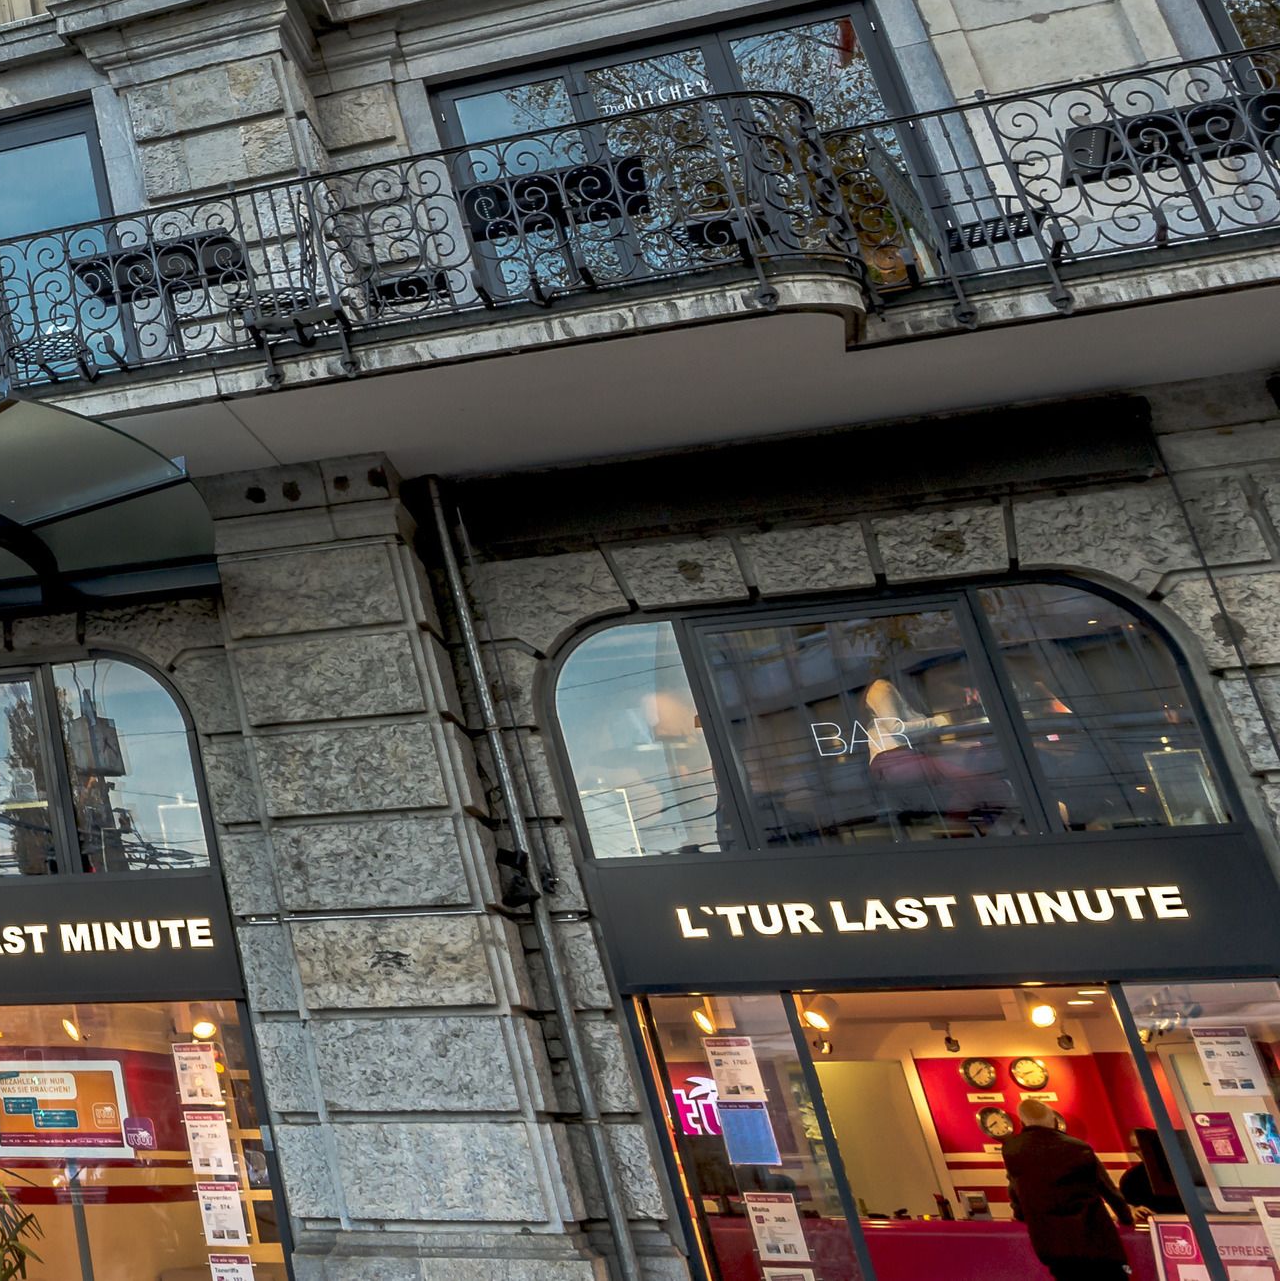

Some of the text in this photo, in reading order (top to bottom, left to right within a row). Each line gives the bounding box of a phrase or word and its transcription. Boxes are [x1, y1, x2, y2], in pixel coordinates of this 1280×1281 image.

[810, 717, 912, 757] BAR
[837, 896, 957, 932] LAST
[974, 886, 1190, 926] MINUTE
[60, 919, 214, 952] MINUTE
